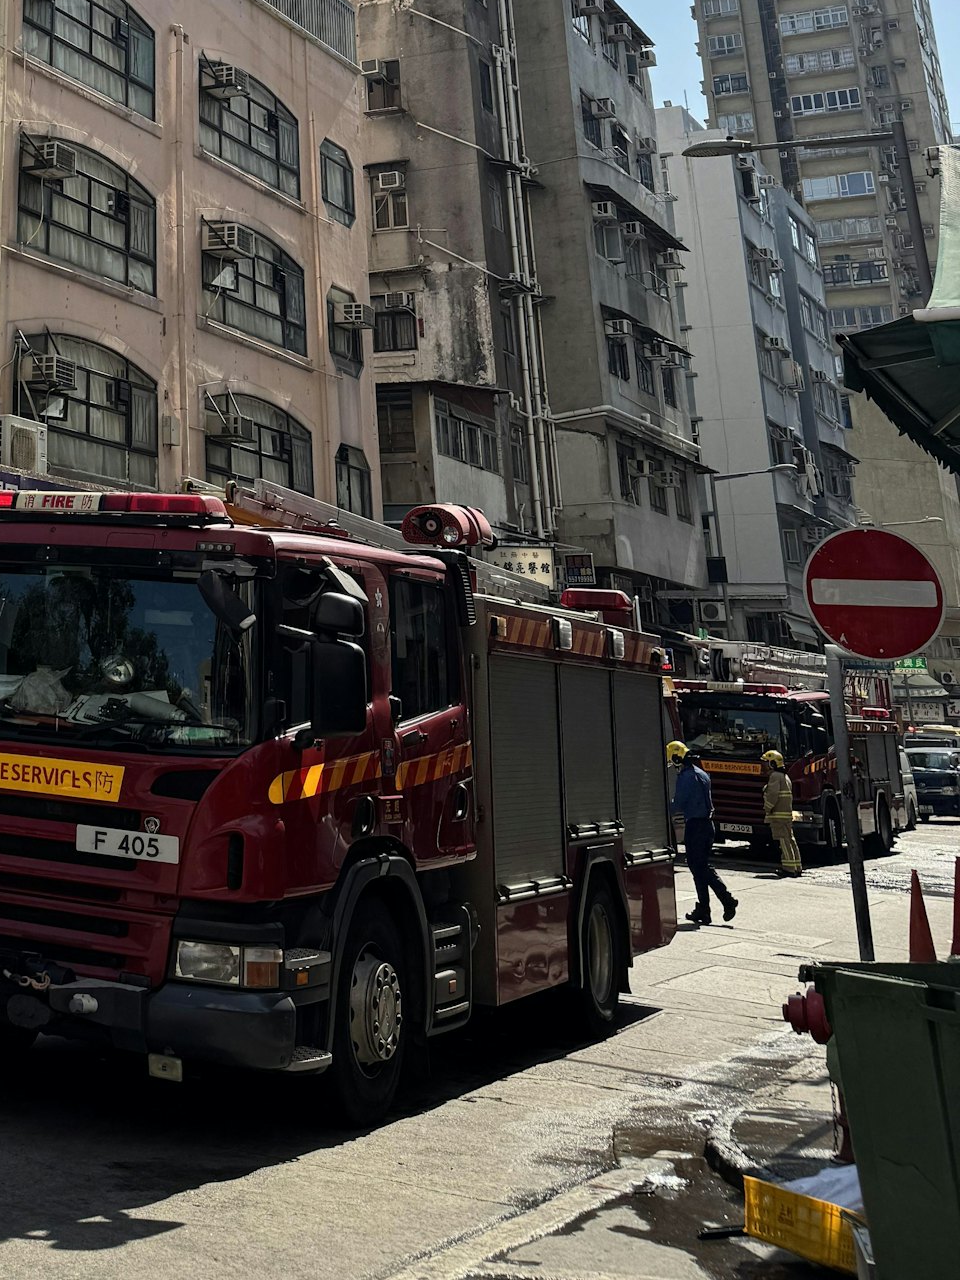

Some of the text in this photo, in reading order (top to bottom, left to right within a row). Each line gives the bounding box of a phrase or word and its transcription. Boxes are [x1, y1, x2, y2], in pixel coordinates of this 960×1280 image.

[41, 495, 76, 509] FIRE
[95, 770, 114, 795] 防
[94, 830, 160, 858] F 405
